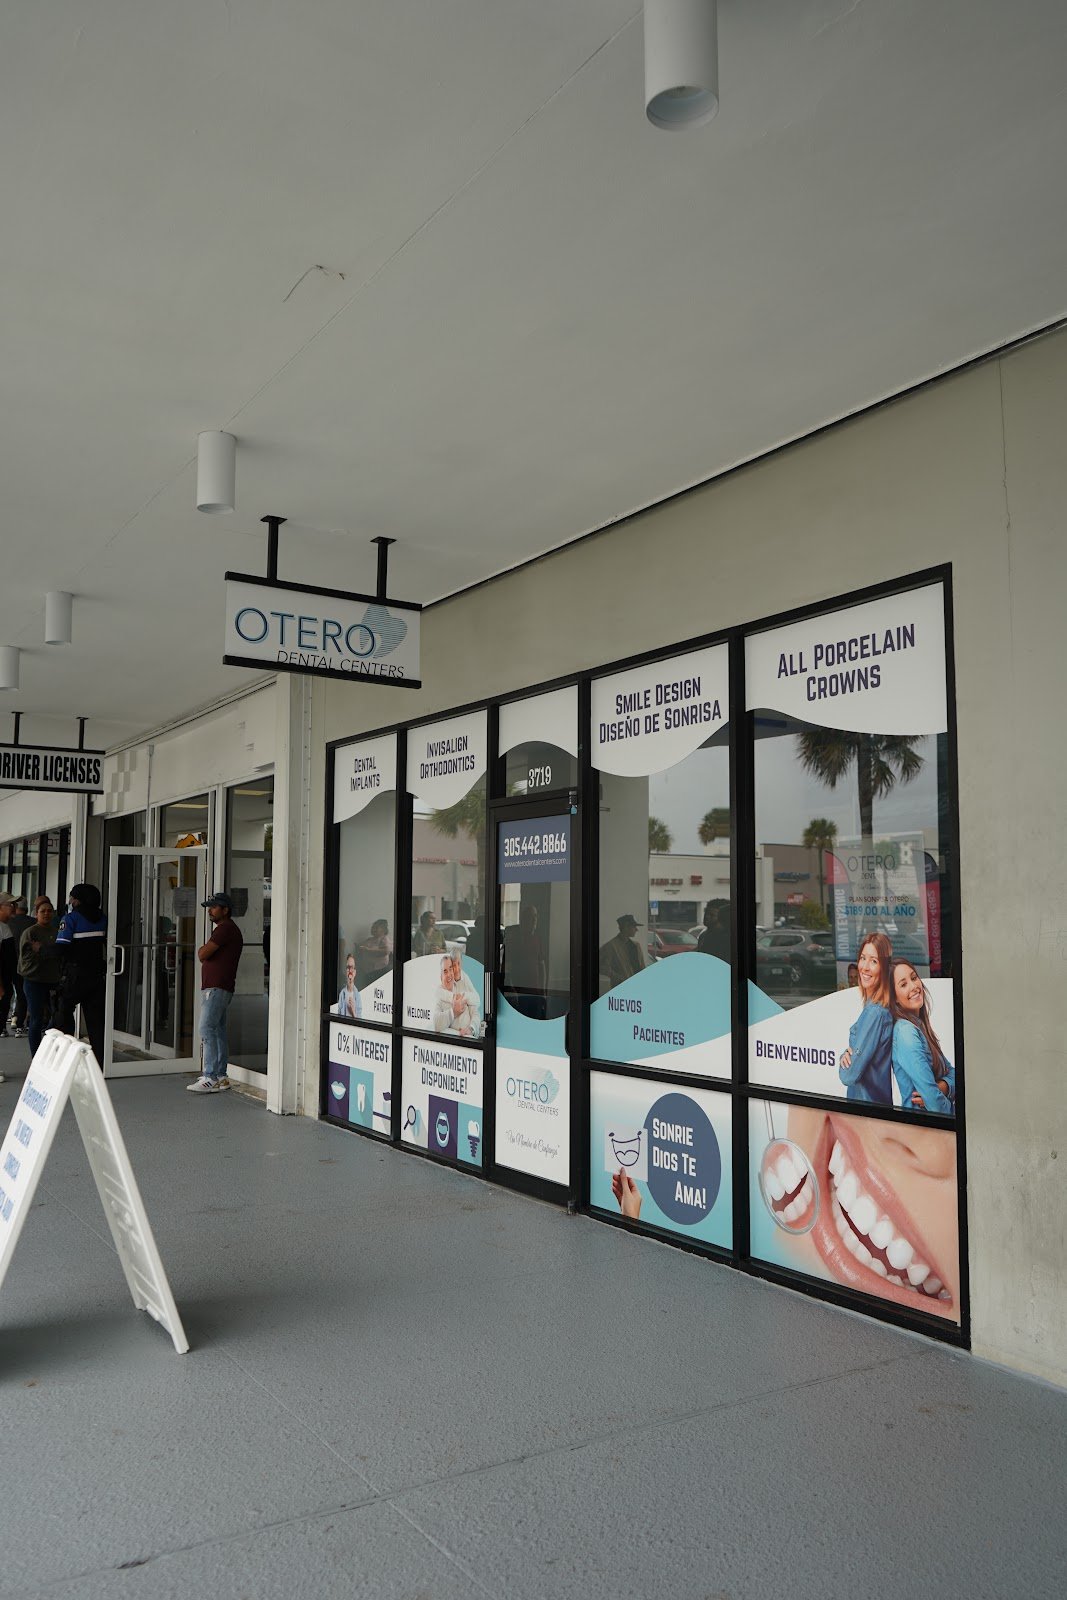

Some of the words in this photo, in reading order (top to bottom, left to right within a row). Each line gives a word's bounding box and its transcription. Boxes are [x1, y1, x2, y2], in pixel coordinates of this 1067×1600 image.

[235, 607, 377, 658] OTERO
[277, 650, 337, 670] DENTAL
[340, 658, 405, 679] CENTERS
[777, 651, 808, 679] ALL
[814, 624, 915, 670] PORCELAIN
[616, 688, 651, 715] SMILE
[655, 677, 701, 706] DESIGN
[807, 665, 881, 702] CROWNS
[600, 715, 640, 744] DISEÑO
[644, 712, 660, 735] DE
[664, 700, 722, 731] SONRISA
[427, 736, 468, 759] INVISALIGN
[0, 752, 40, 780] RIVER
[43, 755, 100, 785] LICENSES
[354, 756, 376, 774] DENTAL
[420, 755, 475, 779] ORTHODONTICS
[528, 765, 552, 788] 3719
[350, 774, 380, 792] IMPLANTS
[504, 832, 567, 857] 305.442.8866
[848, 855, 896, 872] OTERO
[881, 905, 892, 916] AL
[894, 903, 916, 917] AÑO
[374, 987, 385, 1000] NEW
[608, 996, 642, 1013] NUEVOS
[407, 1005, 431, 1020] WELCOME
[337, 1032, 350, 1054] 0%
[352, 1034, 390, 1063] INTEREST
[633, 1025, 685, 1046] PACIENTES
[413, 1045, 478, 1075] FINANCIAMIENTO
[756, 1040, 836, 1067] BIENVENIDOS
[421, 1067, 467, 1095] DISPONIBLE!
[506, 1077, 549, 1103] OTERO
[517, 1100, 536, 1112] DENTAL
[537, 1104, 559, 1117] CENTERS
[652, 1117, 693, 1147] SONRIE
[652, 1145, 678, 1172] DIOS
[681, 1152, 696, 1177] TE
[675, 1181, 706, 1210] AMA!
